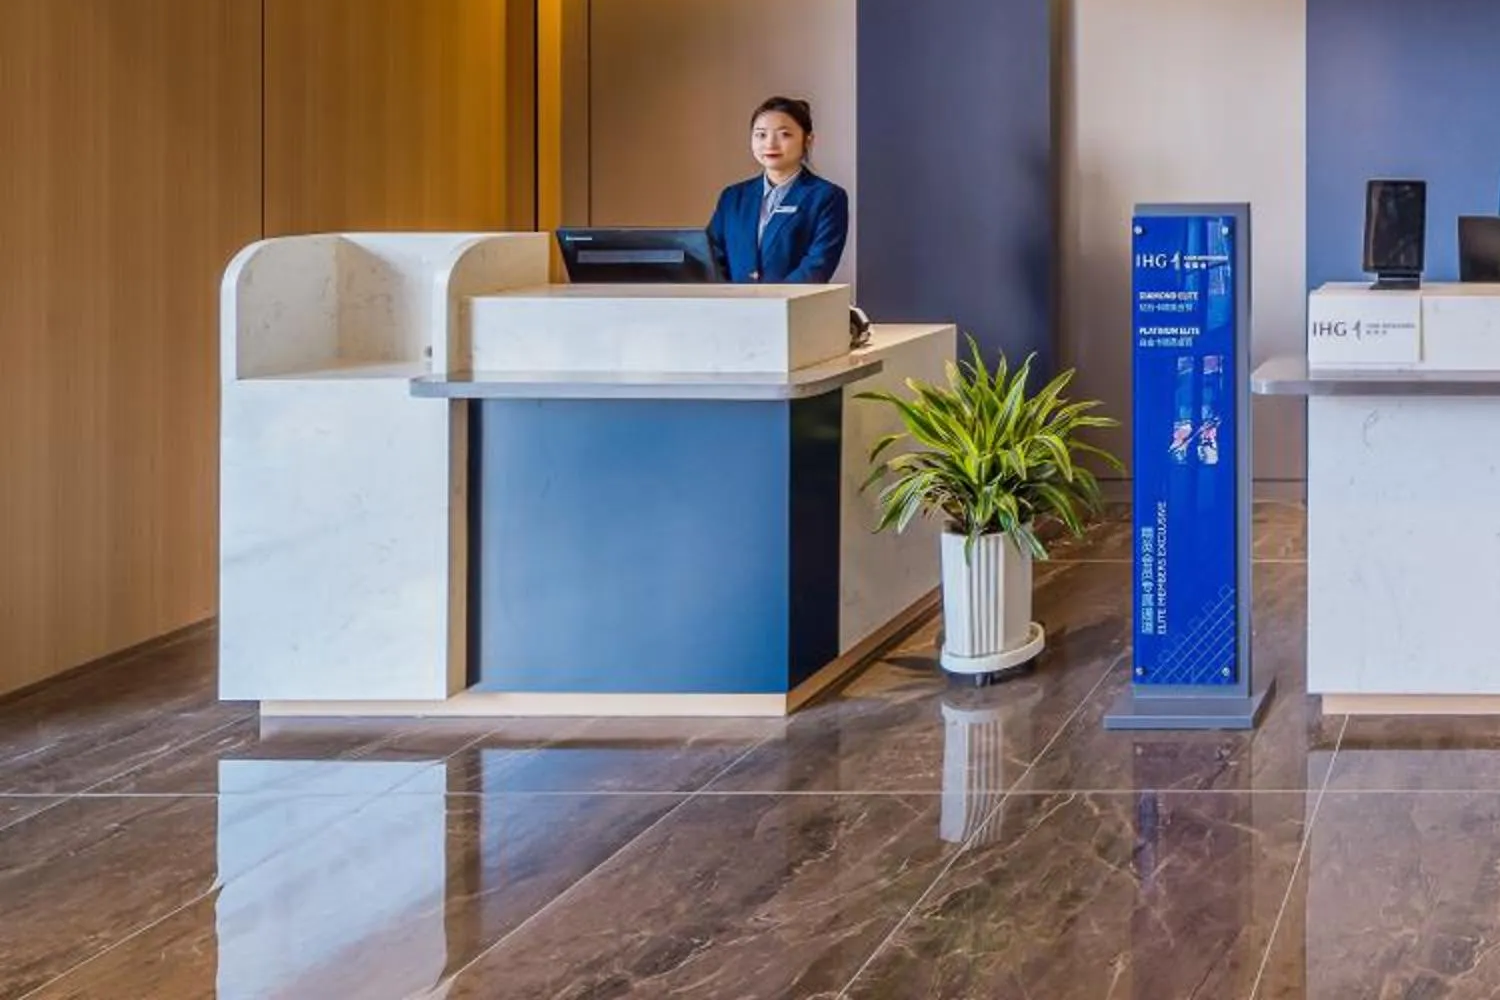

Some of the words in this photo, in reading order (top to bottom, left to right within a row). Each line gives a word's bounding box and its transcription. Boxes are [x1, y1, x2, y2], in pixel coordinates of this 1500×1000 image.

[1135, 254, 1167, 268] IHG
[1313, 321, 1347, 337] IHG
[1157, 501, 1167, 557] EXCLUSIVE
[1157, 558, 1167, 607] MEMBERS
[1157, 608, 1167, 635] ELITE
